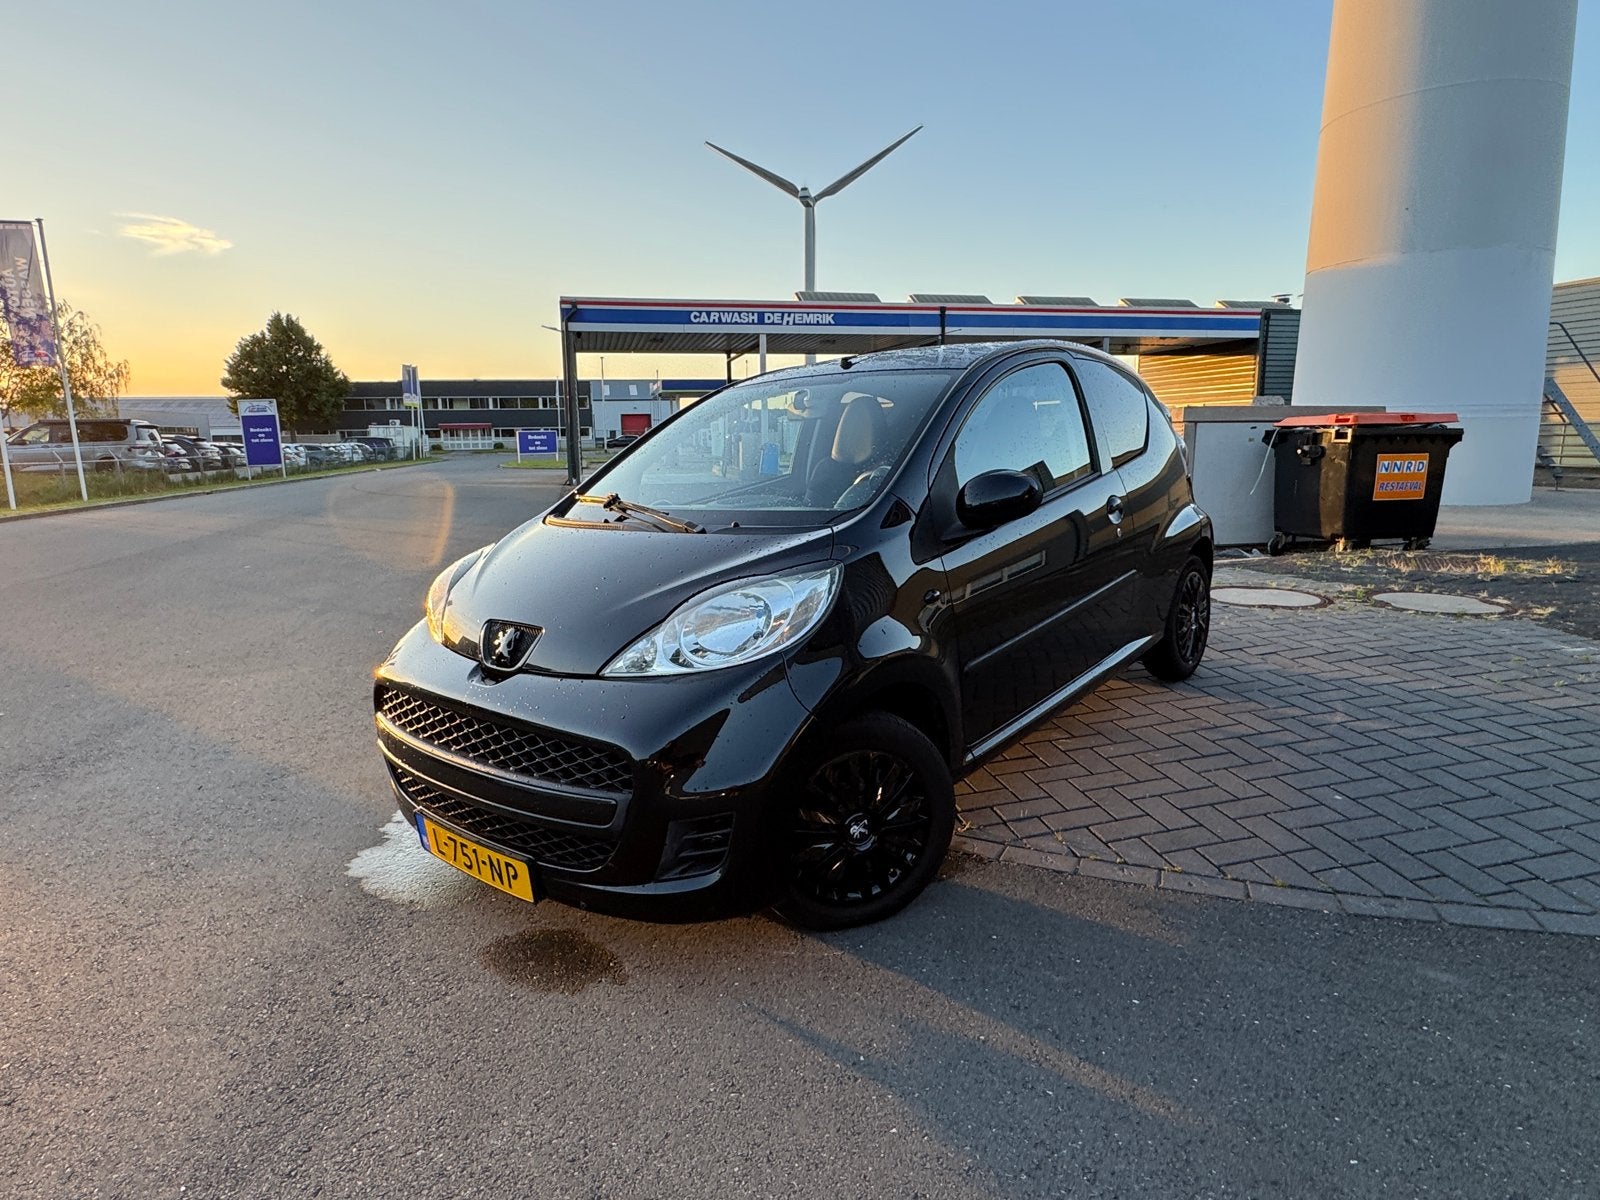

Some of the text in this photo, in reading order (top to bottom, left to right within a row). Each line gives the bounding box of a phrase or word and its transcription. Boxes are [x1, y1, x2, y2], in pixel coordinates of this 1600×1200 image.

[690, 311, 758, 324] CARWASH
[1380, 461, 1425, 473] NNRD
[1378, 481, 1423, 491] RESTAFVAL
[432, 827, 518, 890] L-751-NP
